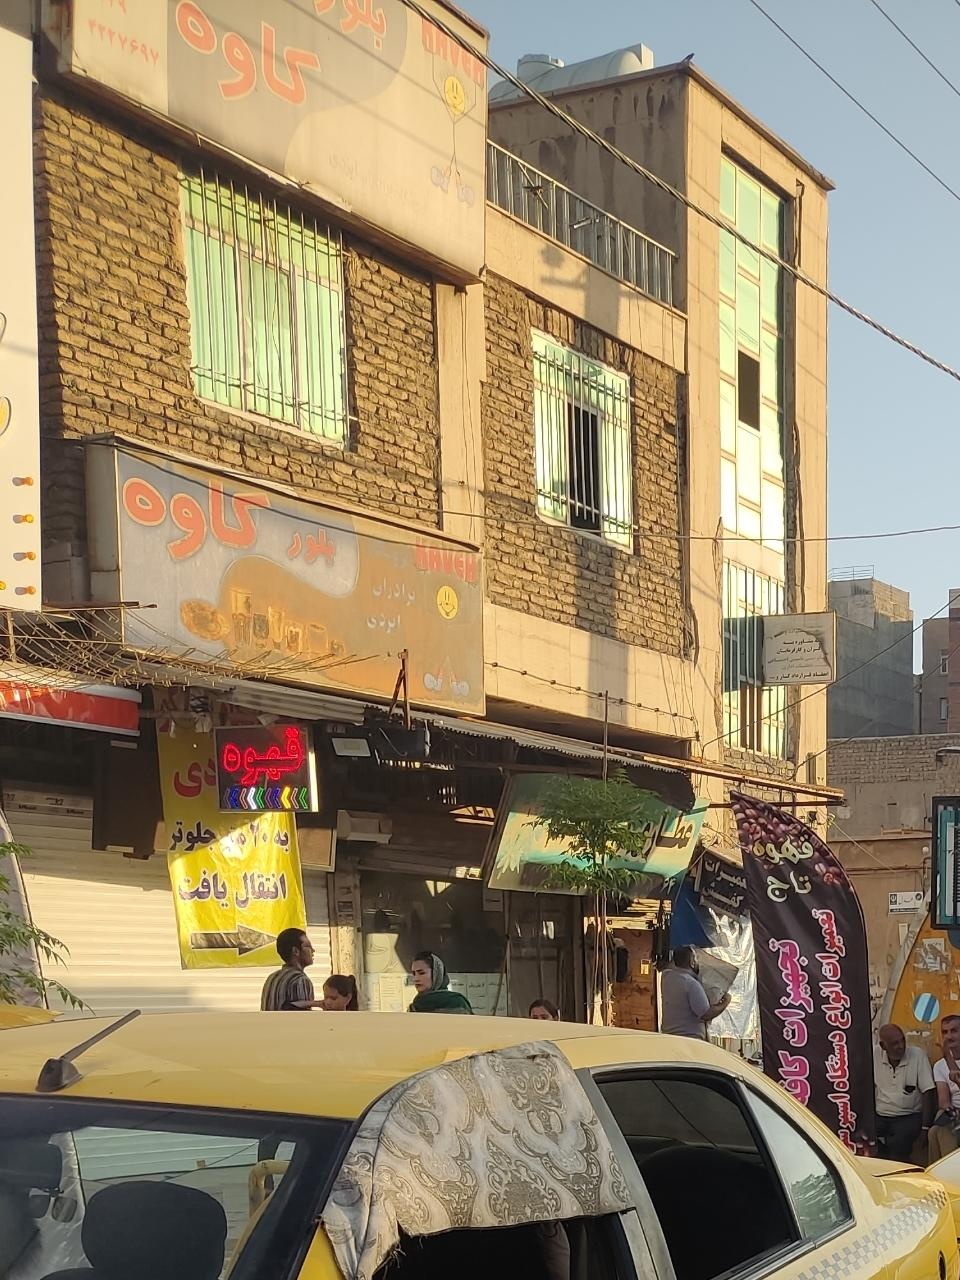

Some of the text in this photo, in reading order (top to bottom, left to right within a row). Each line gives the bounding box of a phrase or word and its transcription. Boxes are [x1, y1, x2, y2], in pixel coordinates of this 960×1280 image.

[176, 0, 321, 105] کاوه
[123, 477, 336, 567] بلور کاوه
[415, 537, 478, 582] KAVEH
[222, 727, 304, 787] قهوه
[169, 820, 217, 852] جلوتر
[274, 829, 289, 853] به
[752, 834, 814, 865] قهوه
[179, 869, 287, 908] انتقال یافت
[766, 870, 812, 903] تاج
[812, 908, 846, 981] تعمیرات
[768, 938, 814, 1047] تجهیزات
[819, 981, 852, 1029] انواع
[826, 1030, 850, 1091] دستگاه
